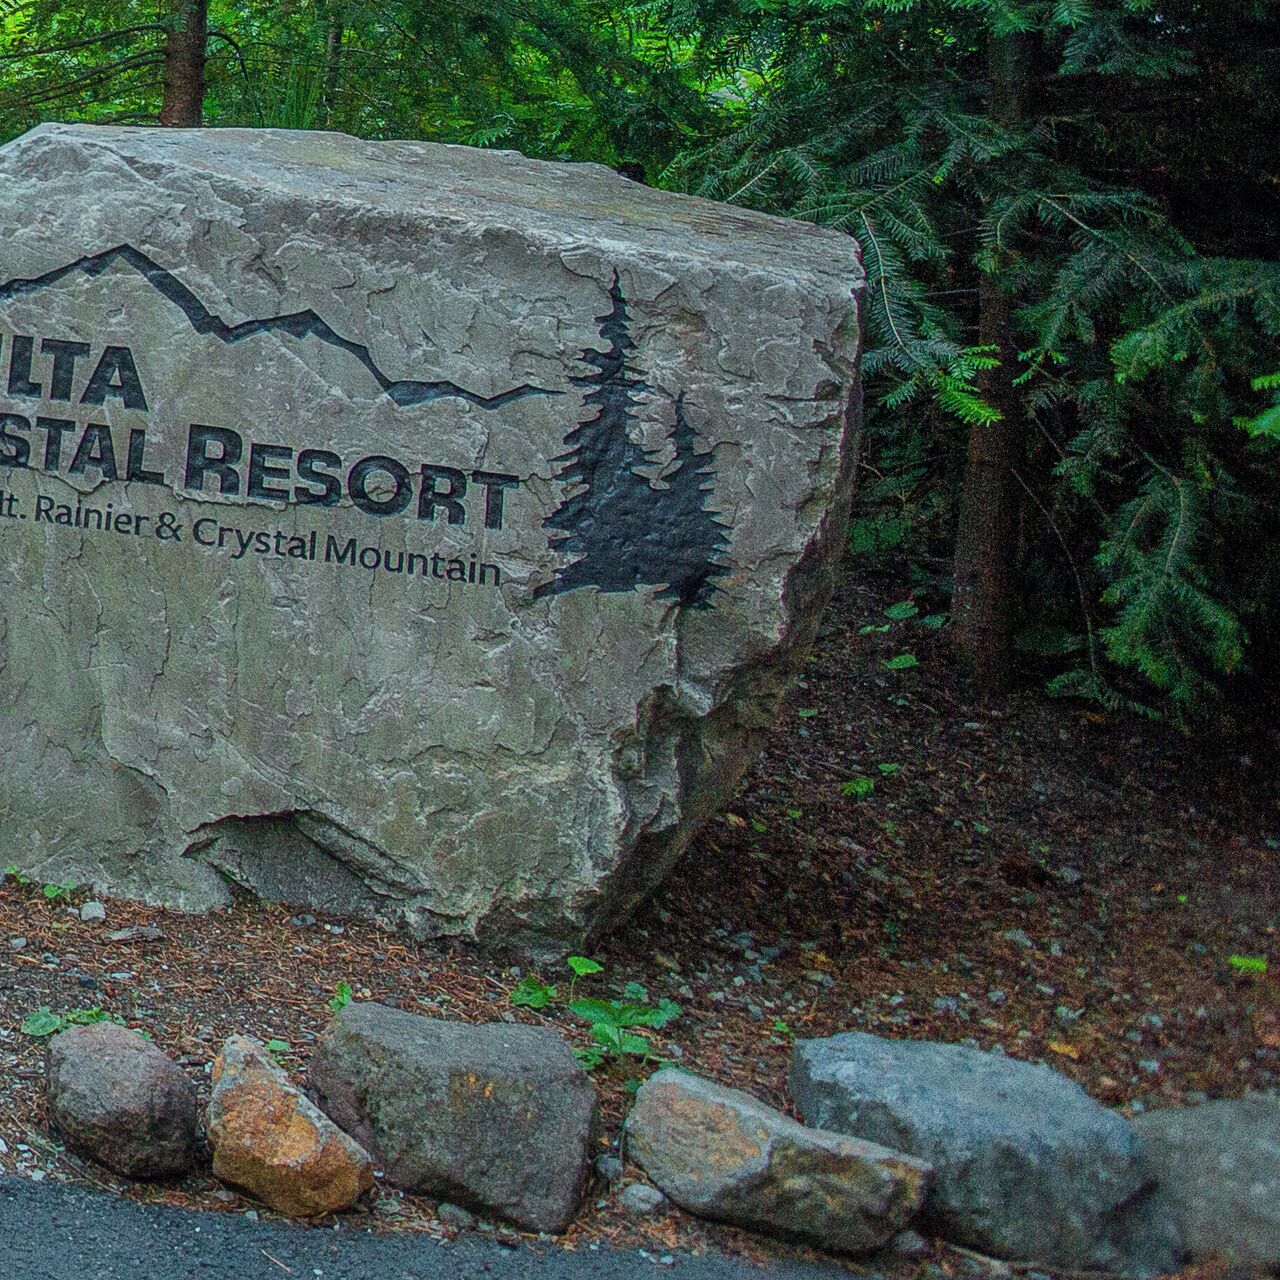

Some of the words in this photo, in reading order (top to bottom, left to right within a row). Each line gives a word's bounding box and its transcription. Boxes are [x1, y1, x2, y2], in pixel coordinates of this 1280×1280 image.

[183, 423, 520, 531] RESORT
[37, 494, 151, 536] Rainier
[155, 510, 183, 543] &
[192, 517, 317, 561] Crystal
[324, 533, 502, 588] Mountain
